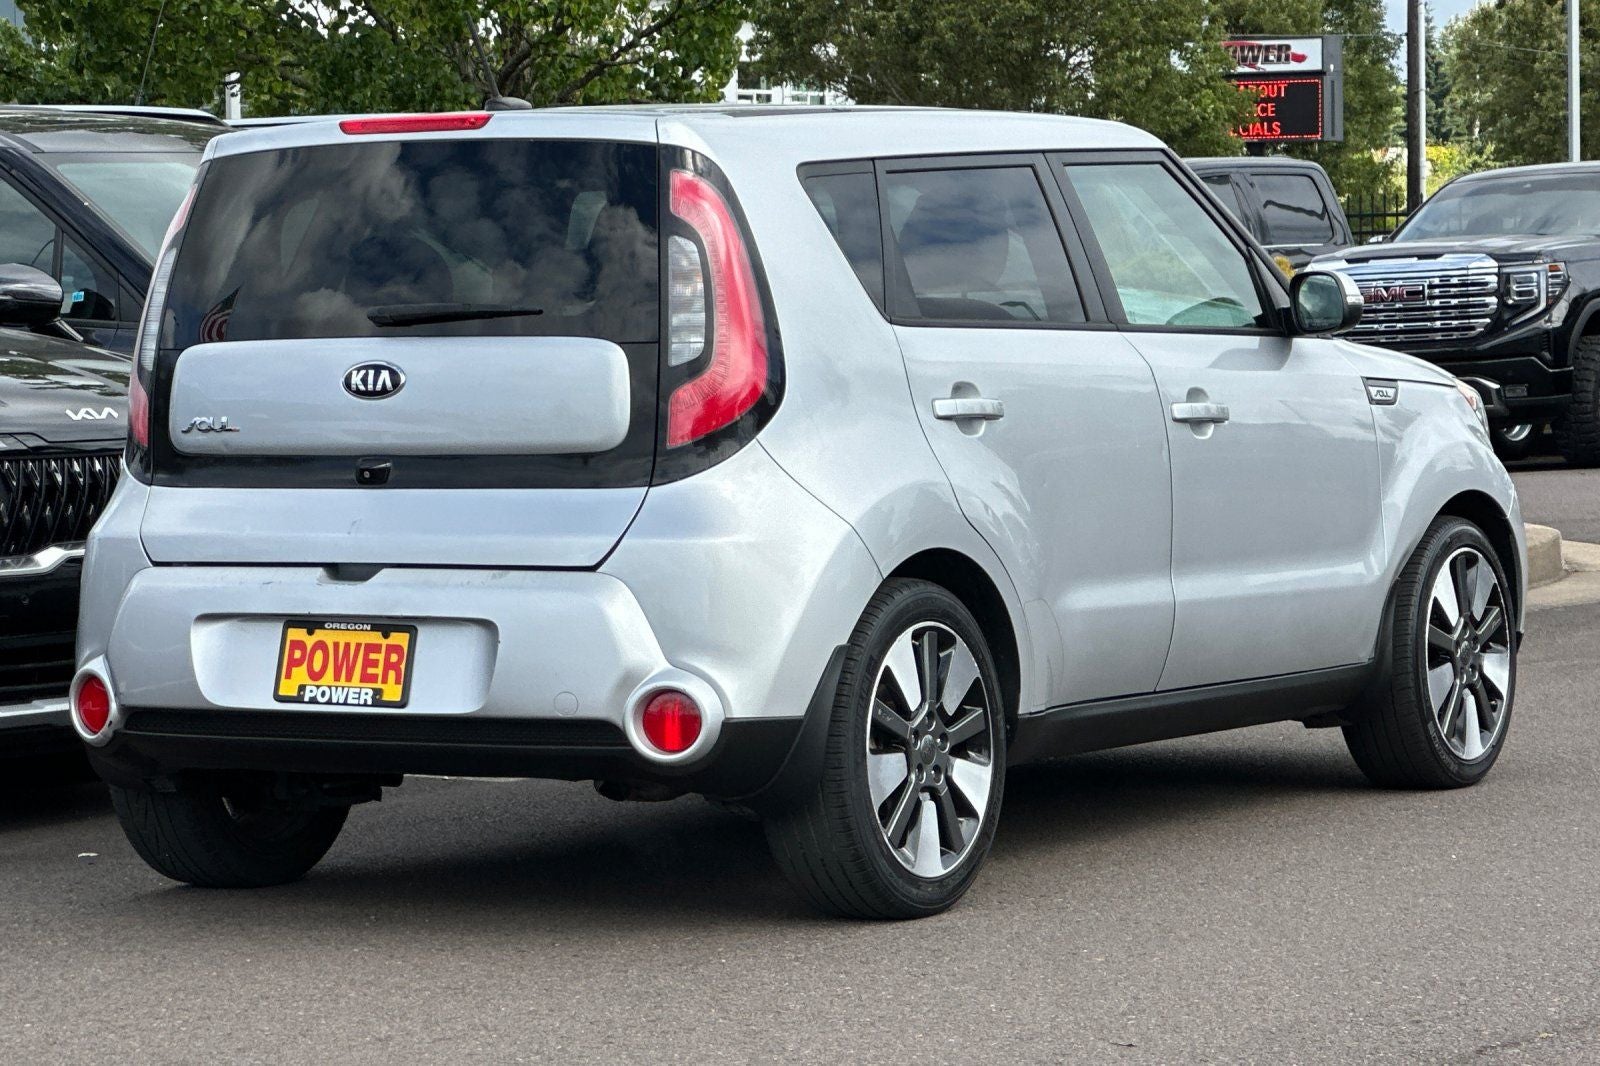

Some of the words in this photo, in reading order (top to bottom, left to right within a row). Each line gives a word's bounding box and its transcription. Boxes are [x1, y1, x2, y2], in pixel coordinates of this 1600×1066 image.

[351, 369, 394, 391] KIA
[180, 415, 241, 434] SOUL
[324, 622, 371, 631] OREGON
[284, 639, 405, 686] POWER
[303, 685, 374, 705] POWER
